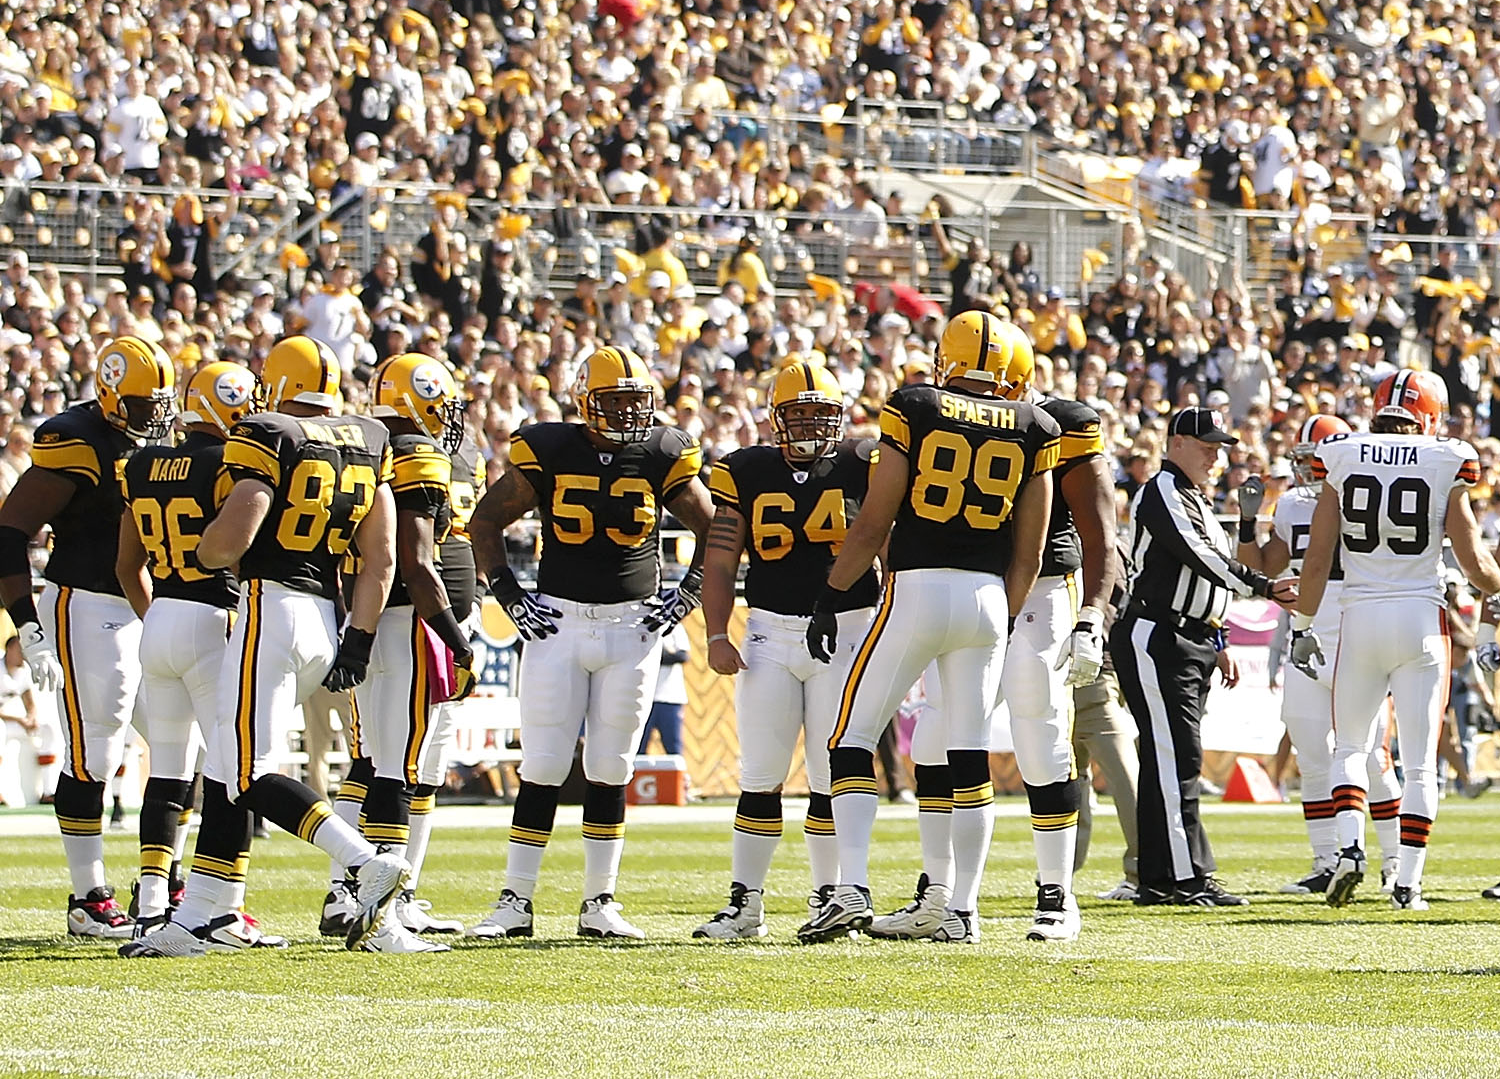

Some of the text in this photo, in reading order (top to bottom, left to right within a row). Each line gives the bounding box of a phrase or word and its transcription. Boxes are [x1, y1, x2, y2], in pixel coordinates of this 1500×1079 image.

[940, 394, 1016, 430] SPAETH
[148, 456, 193, 482] WARD
[910, 429, 1025, 530] 89
[1360, 443, 1419, 466] FUJITA
[131, 496, 216, 583] 86
[275, 459, 377, 555] 83
[551, 473, 656, 548] 53
[751, 488, 848, 562] 64
[1341, 473, 1431, 556] 99
[634, 774, 658, 797] G
